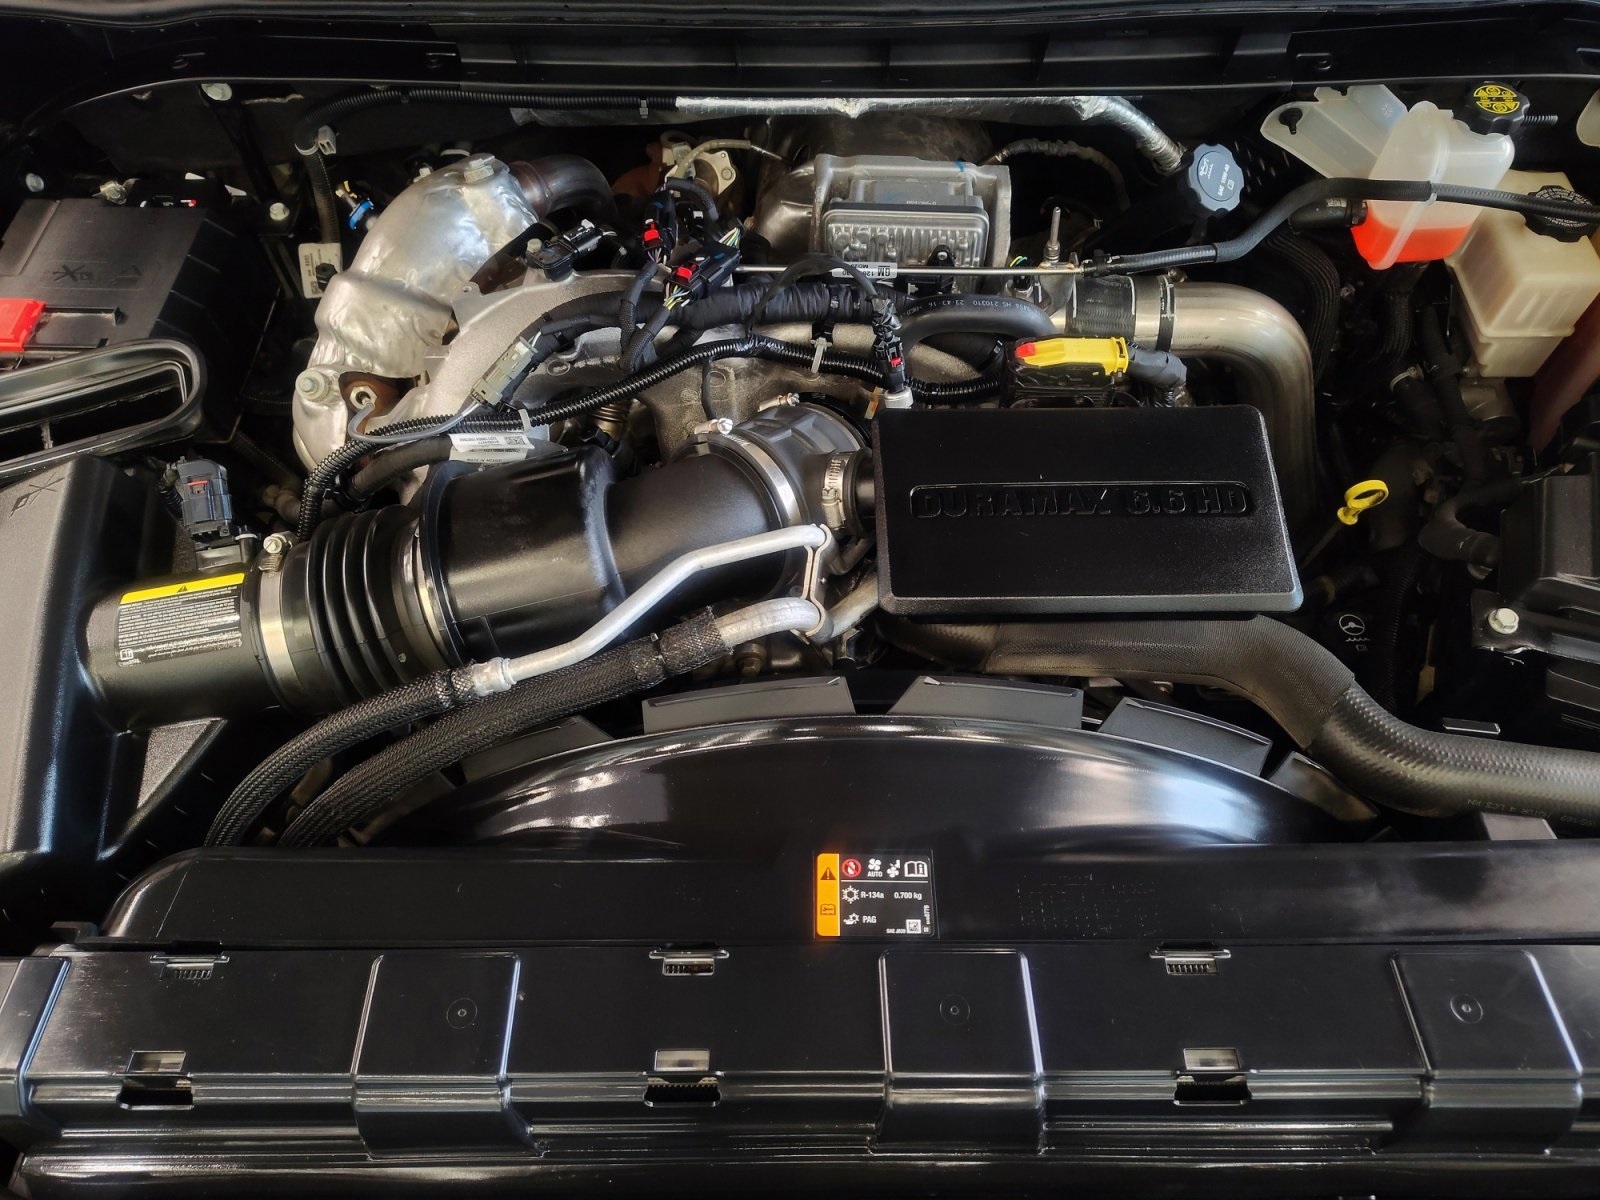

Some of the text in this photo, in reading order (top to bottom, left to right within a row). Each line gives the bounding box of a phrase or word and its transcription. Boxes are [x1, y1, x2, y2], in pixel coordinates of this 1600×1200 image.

[878, 267, 891, 277] GM
[912, 485, 1248, 519] DURAMAX 6.6 HD
[861, 891, 923, 901] R-134a 0.700 kg
[862, 915, 877, 924] PAG
